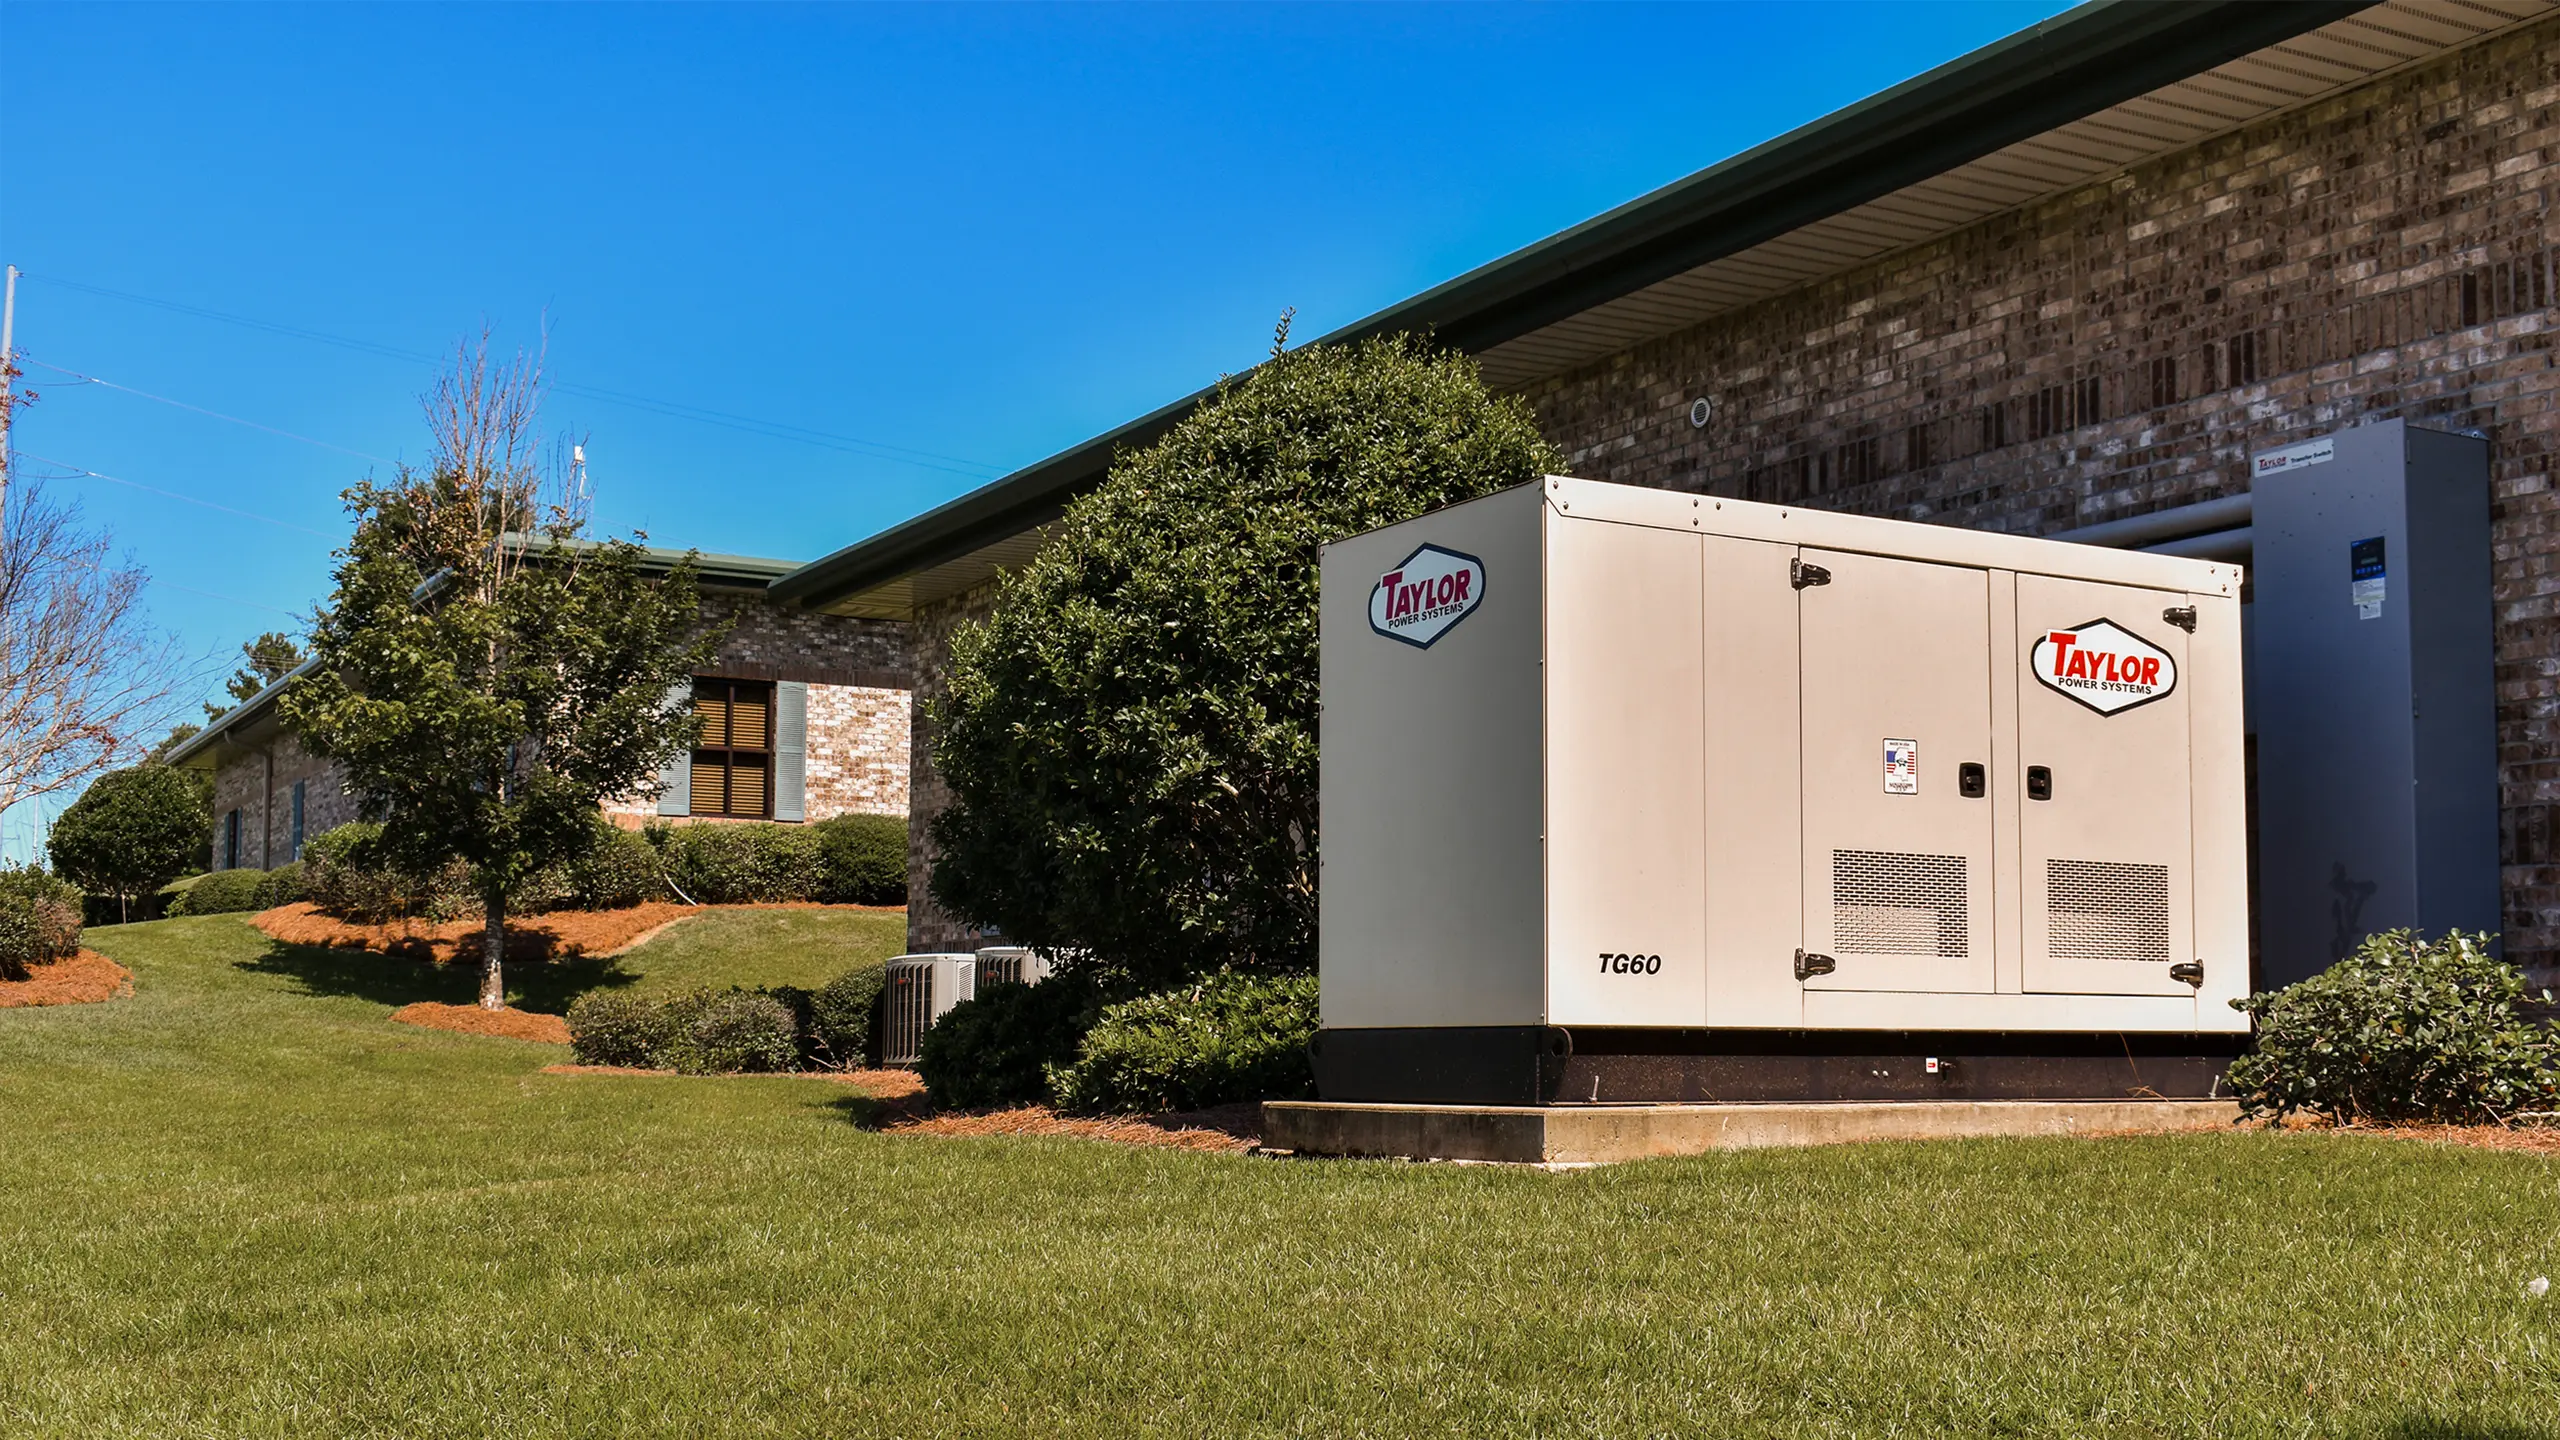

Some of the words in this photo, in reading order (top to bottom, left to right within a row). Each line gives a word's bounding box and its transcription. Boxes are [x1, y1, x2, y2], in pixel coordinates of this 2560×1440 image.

[2258, 456, 2287, 469] TAYLOR
[1382, 569, 1471, 620] TAYLOR
[1388, 613, 1419, 629] POWER
[1421, 602, 1464, 621] SYSTEMS
[2049, 632, 2160, 686] TAYLOR
[2058, 677, 2098, 690] POWER
[2101, 683, 2152, 695] SYSTEMS
[1599, 953, 1662, 975] TG60
